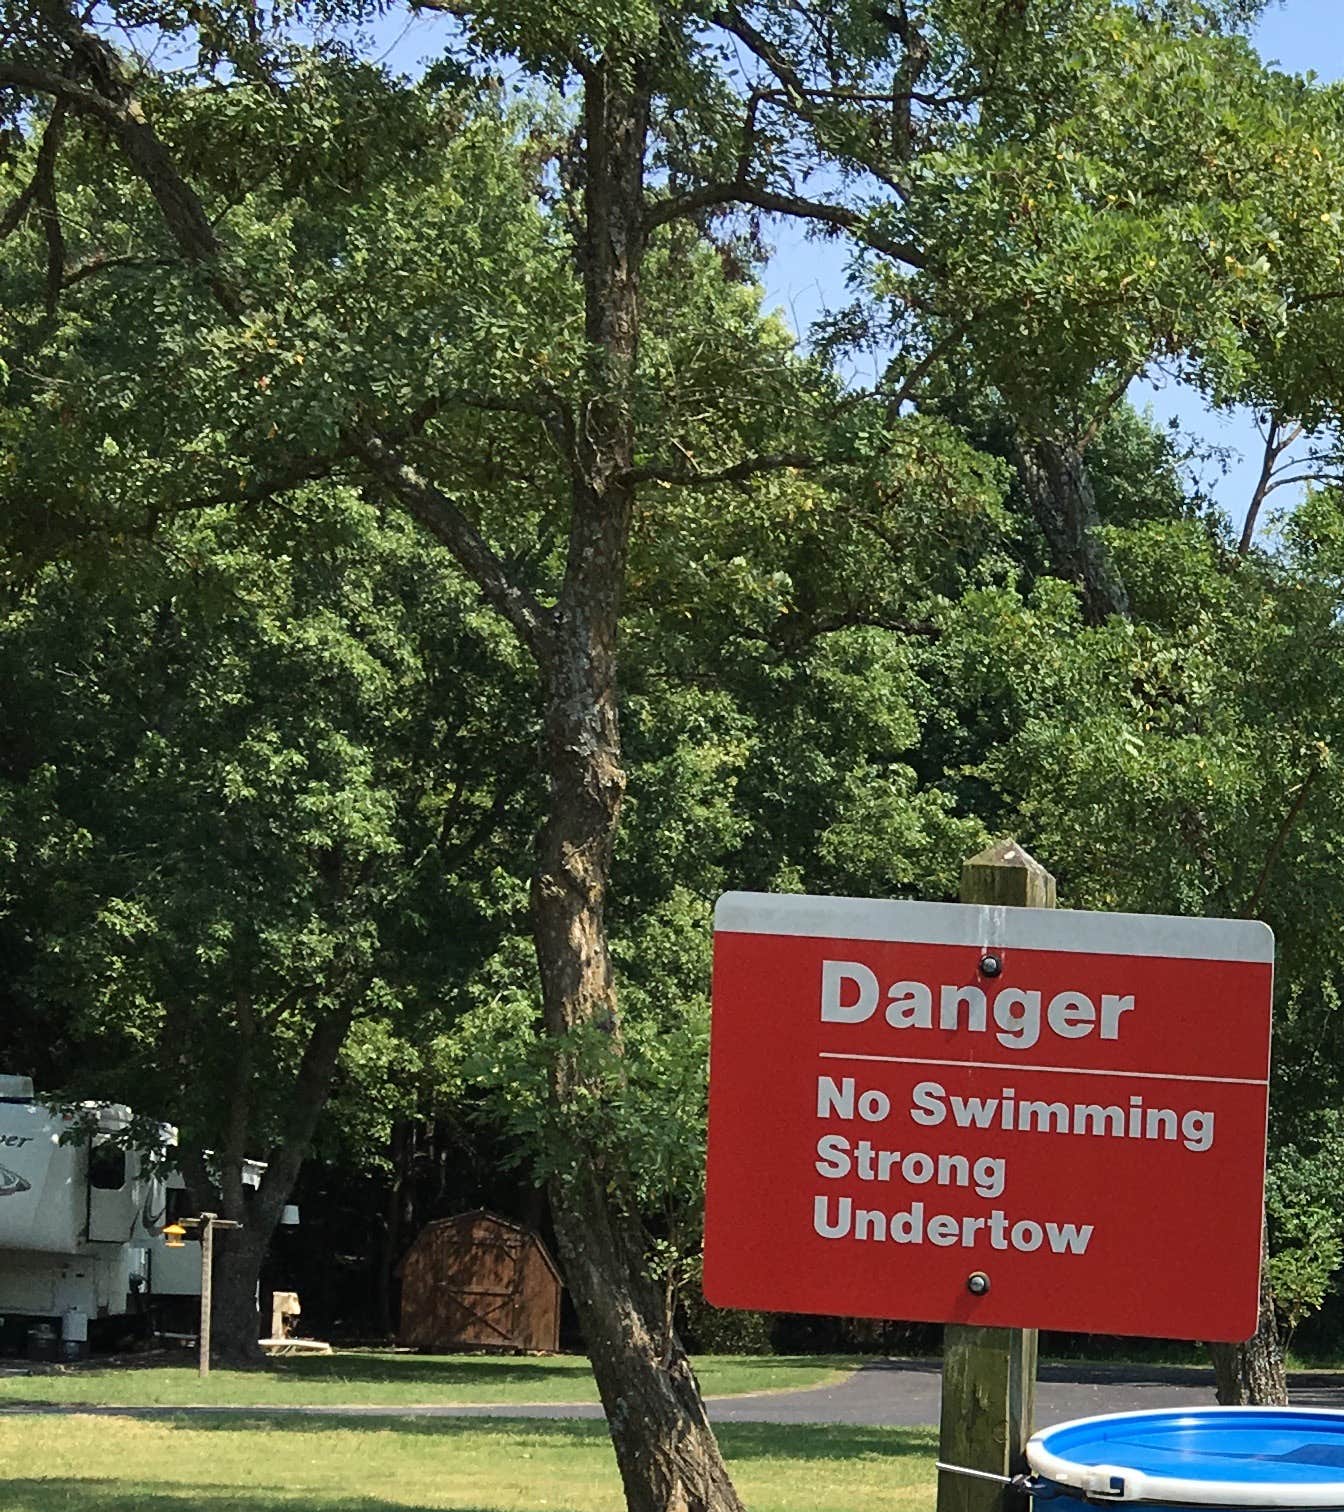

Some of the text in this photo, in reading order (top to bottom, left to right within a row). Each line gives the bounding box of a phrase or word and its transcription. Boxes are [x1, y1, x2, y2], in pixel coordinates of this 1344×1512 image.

[820, 960, 1135, 1049] Danger
[817, 1076, 1215, 1152] No Swimming
[815, 1135, 1006, 1197] Strong
[812, 1196, 1095, 1254] Undertow
